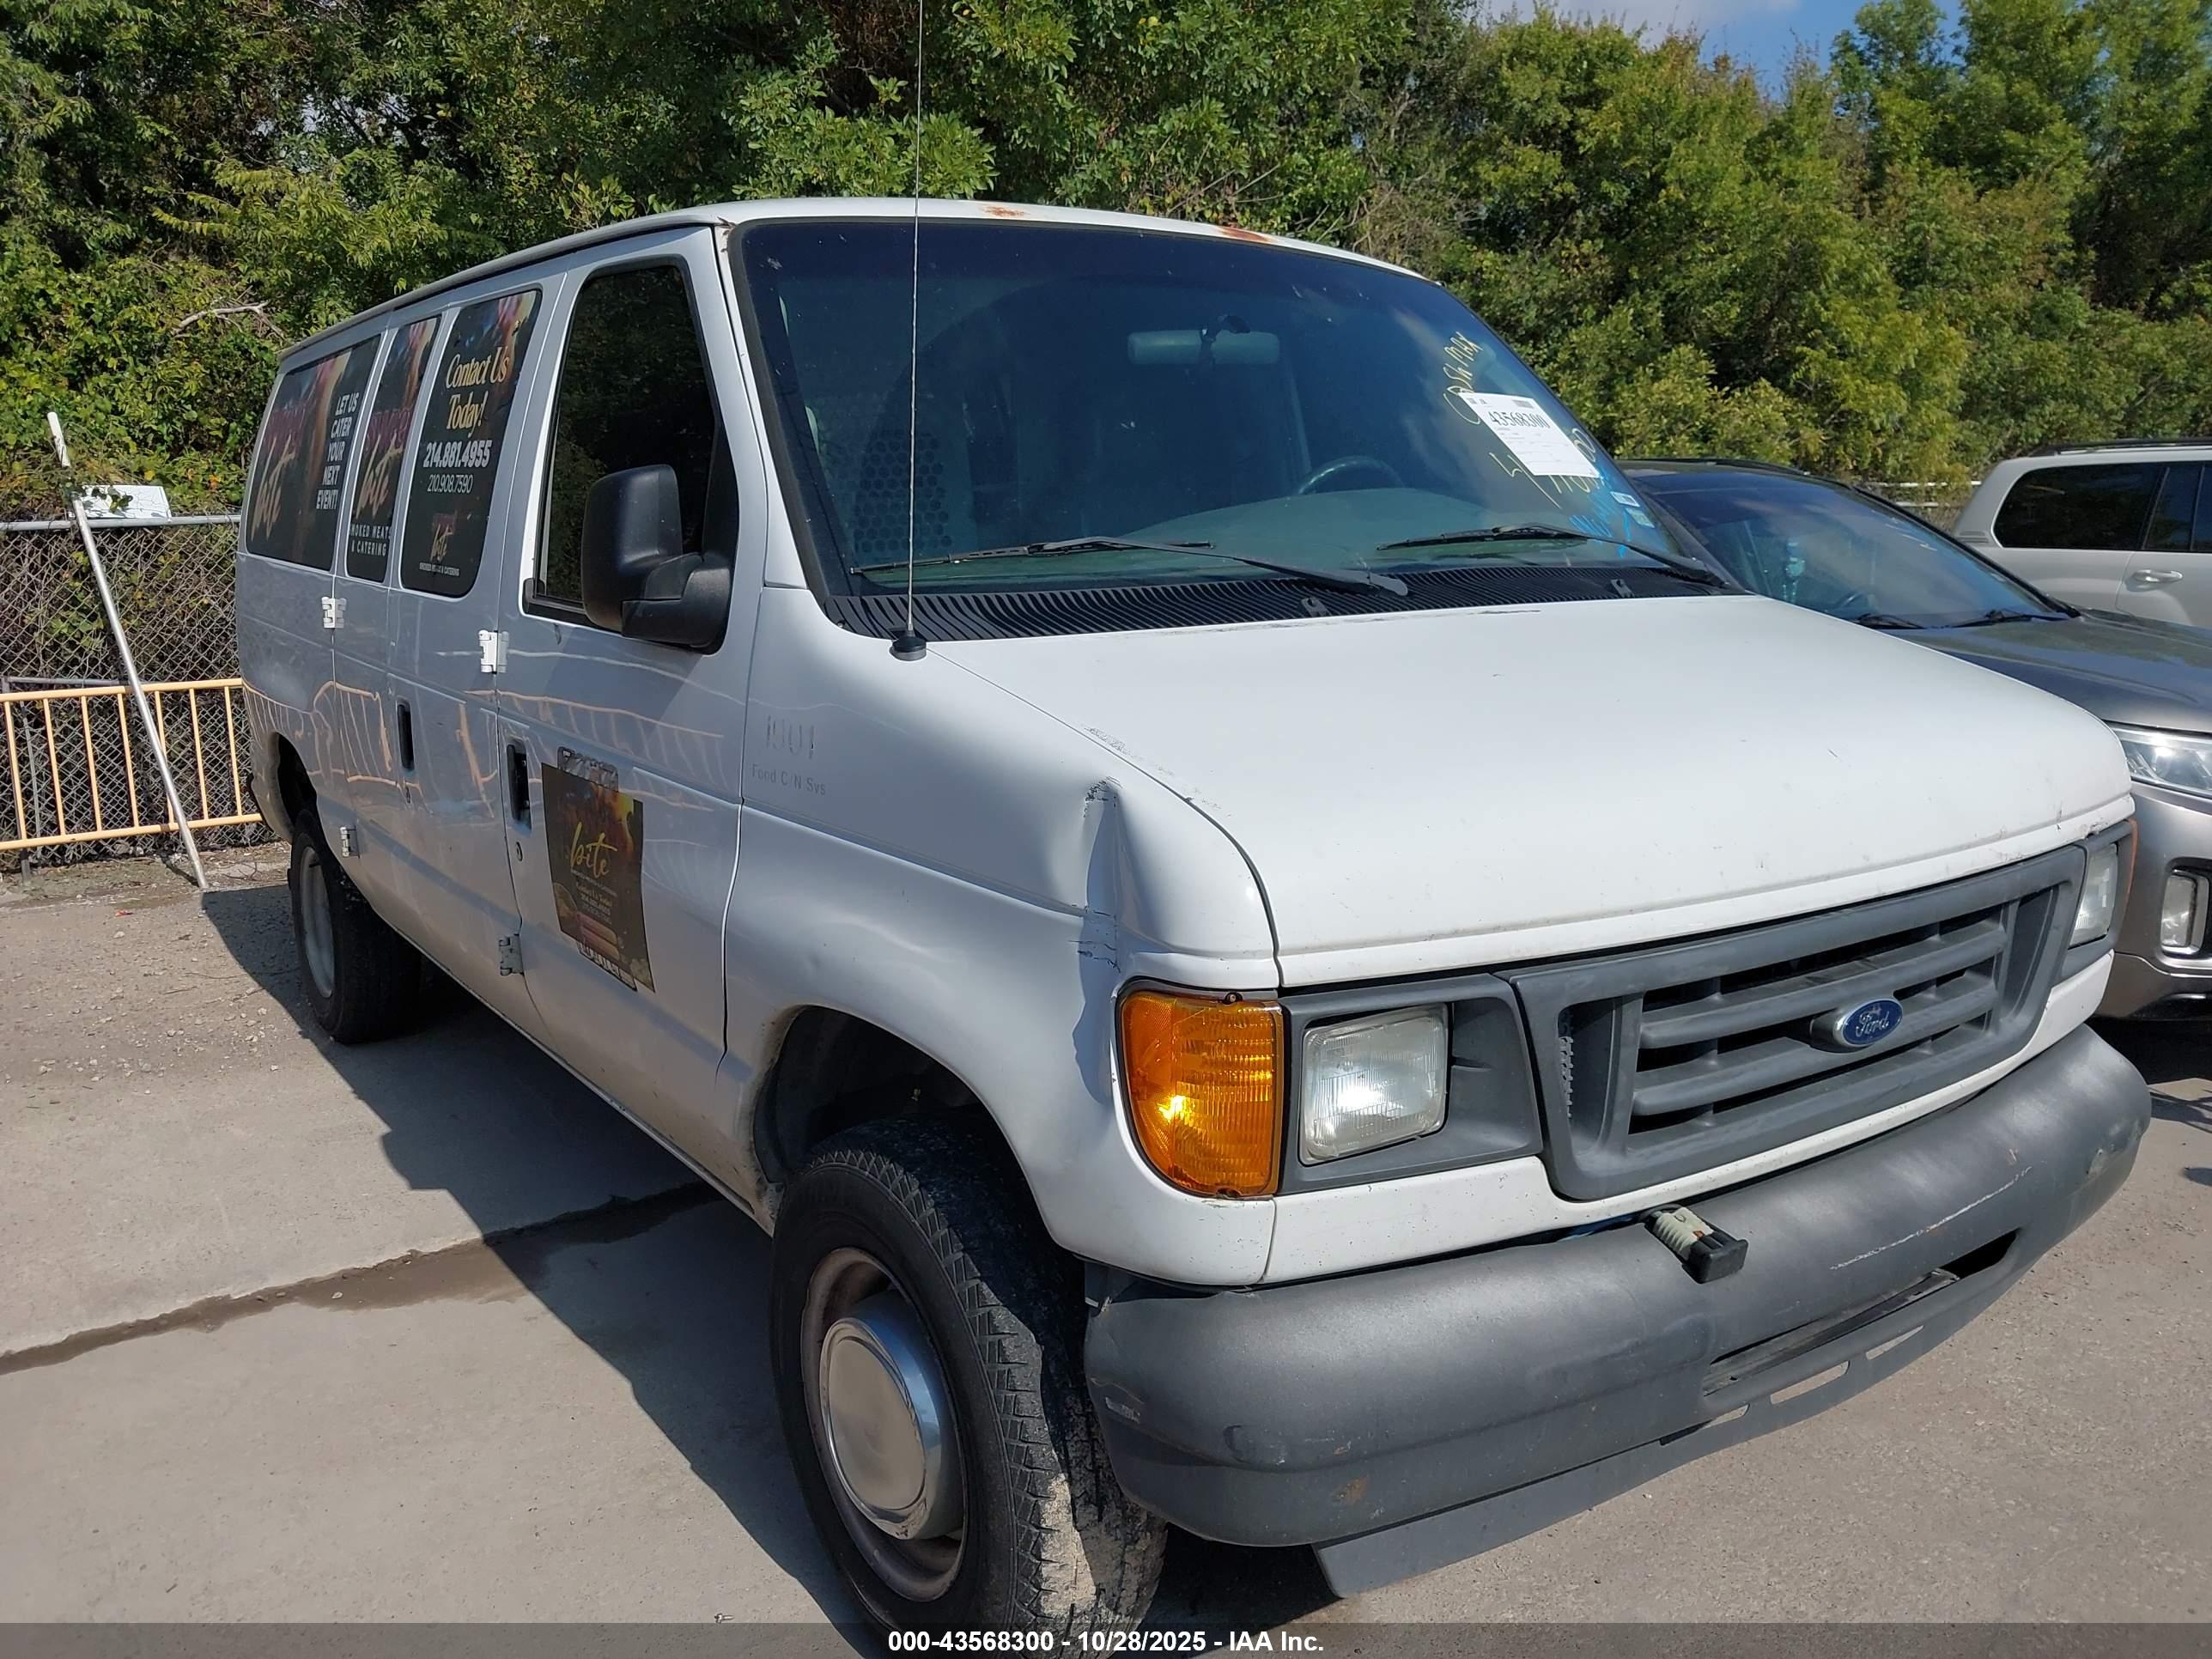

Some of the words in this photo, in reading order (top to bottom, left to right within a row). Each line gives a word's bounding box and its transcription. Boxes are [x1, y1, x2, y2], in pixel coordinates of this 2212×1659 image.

[446, 353, 491, 389] Contact
[490, 345, 510, 384] Us
[335, 394, 349, 416] LET
[349, 391, 360, 414] US
[446, 390, 489, 438] Today!
[331, 418, 352, 440] CATER
[1487, 410, 1551, 428] 43568300
[327, 442, 345, 462] YOUR
[422, 439, 493, 468] 214.881.4955
[322, 465, 340, 486] NEXT
[426, 474, 474, 494] 210.908.7590
[315, 489, 338, 510] EVENT!
[349, 524, 370, 538] MOKED
[356, 540, 387, 556] CATERING
[570, 821, 617, 879] bite
[1855, 1010, 1890, 1037] Ford
